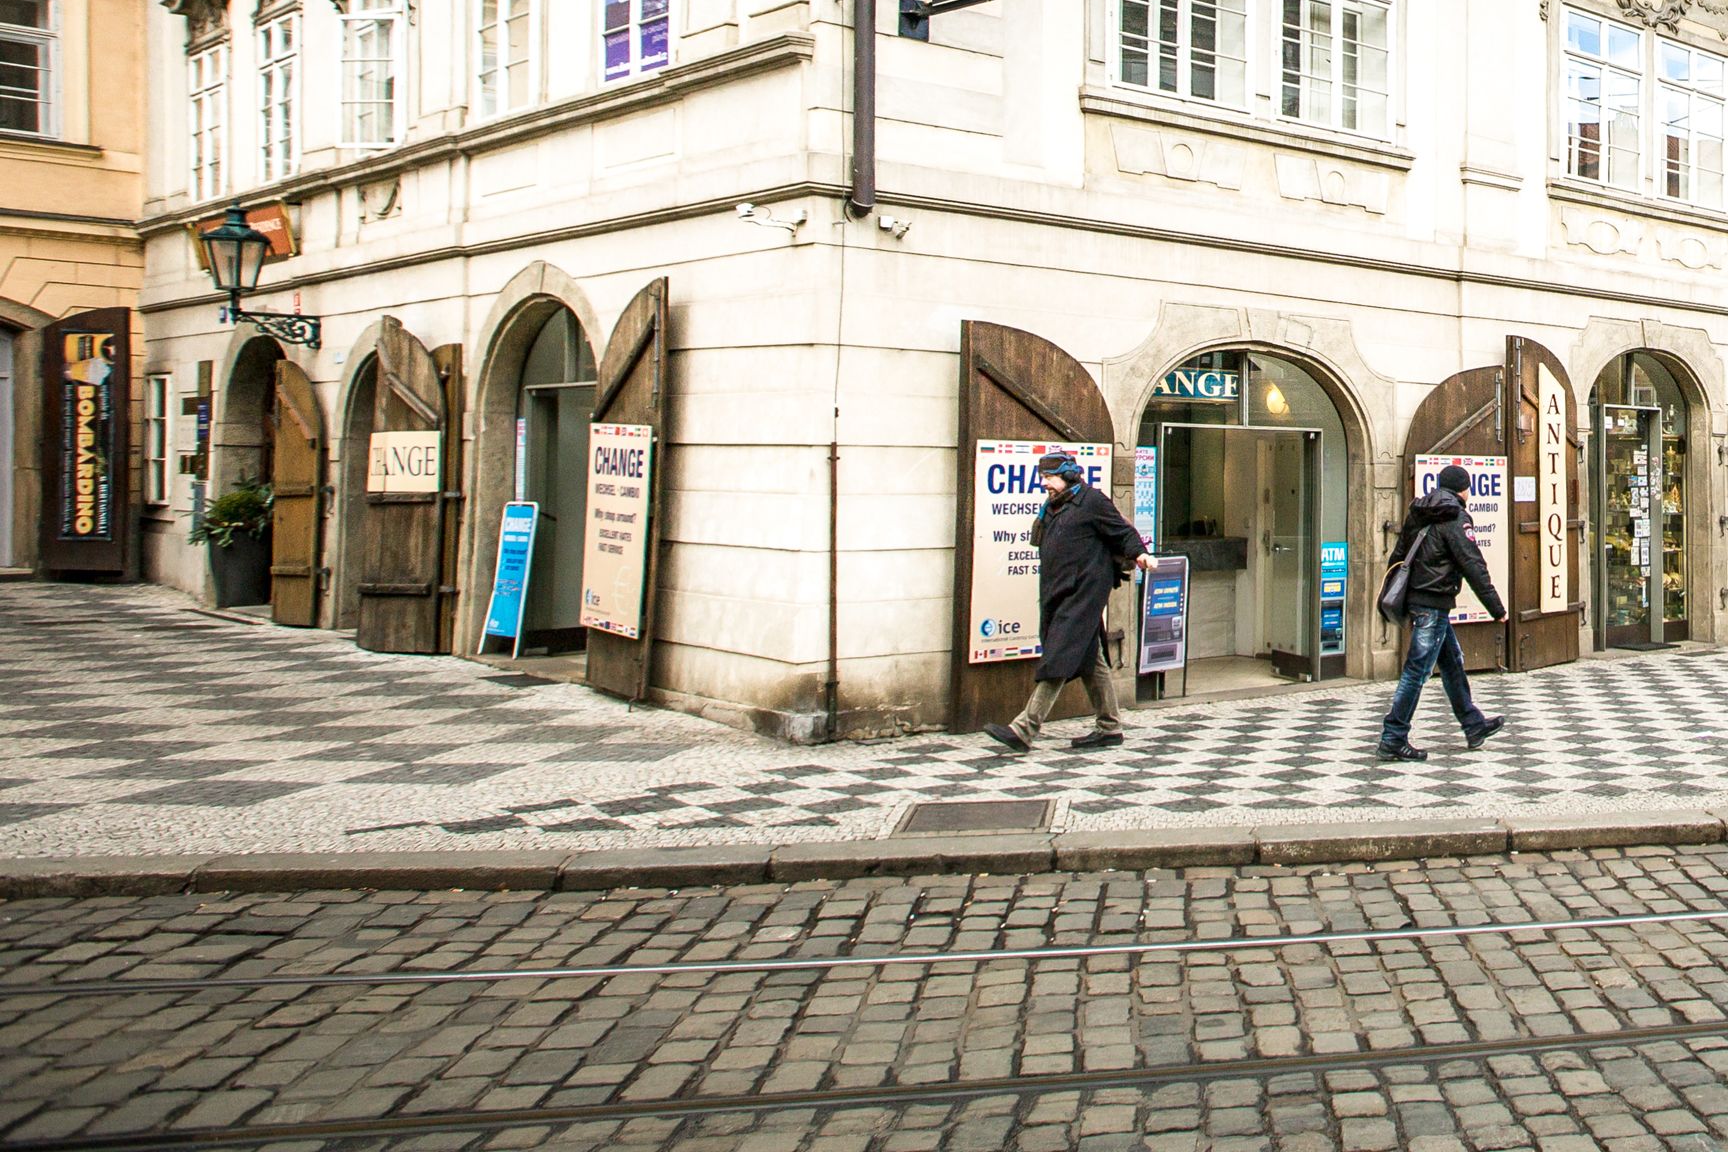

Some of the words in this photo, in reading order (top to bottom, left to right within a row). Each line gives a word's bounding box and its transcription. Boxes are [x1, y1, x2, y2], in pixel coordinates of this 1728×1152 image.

[1154, 370, 1239, 398] ANGE
[75, 385, 96, 535] BOMBARDINO
[594, 446, 645, 478] CHANGE
[987, 463, 1103, 494] CHAE
[1422, 472, 1502, 497] CNGE
[1546, 393, 1562, 599] ANTIQUE
[991, 502, 1043, 516] WECHSE
[1468, 502, 1499, 513] CAMBIO
[1473, 523, 1496, 534] ound?
[992, 530, 1017, 544] Why
[1020, 530, 1033, 543] sh
[1321, 547, 1346, 562] ATM
[1007, 565, 1030, 576] FAST
[997, 619, 1022, 635] ice
